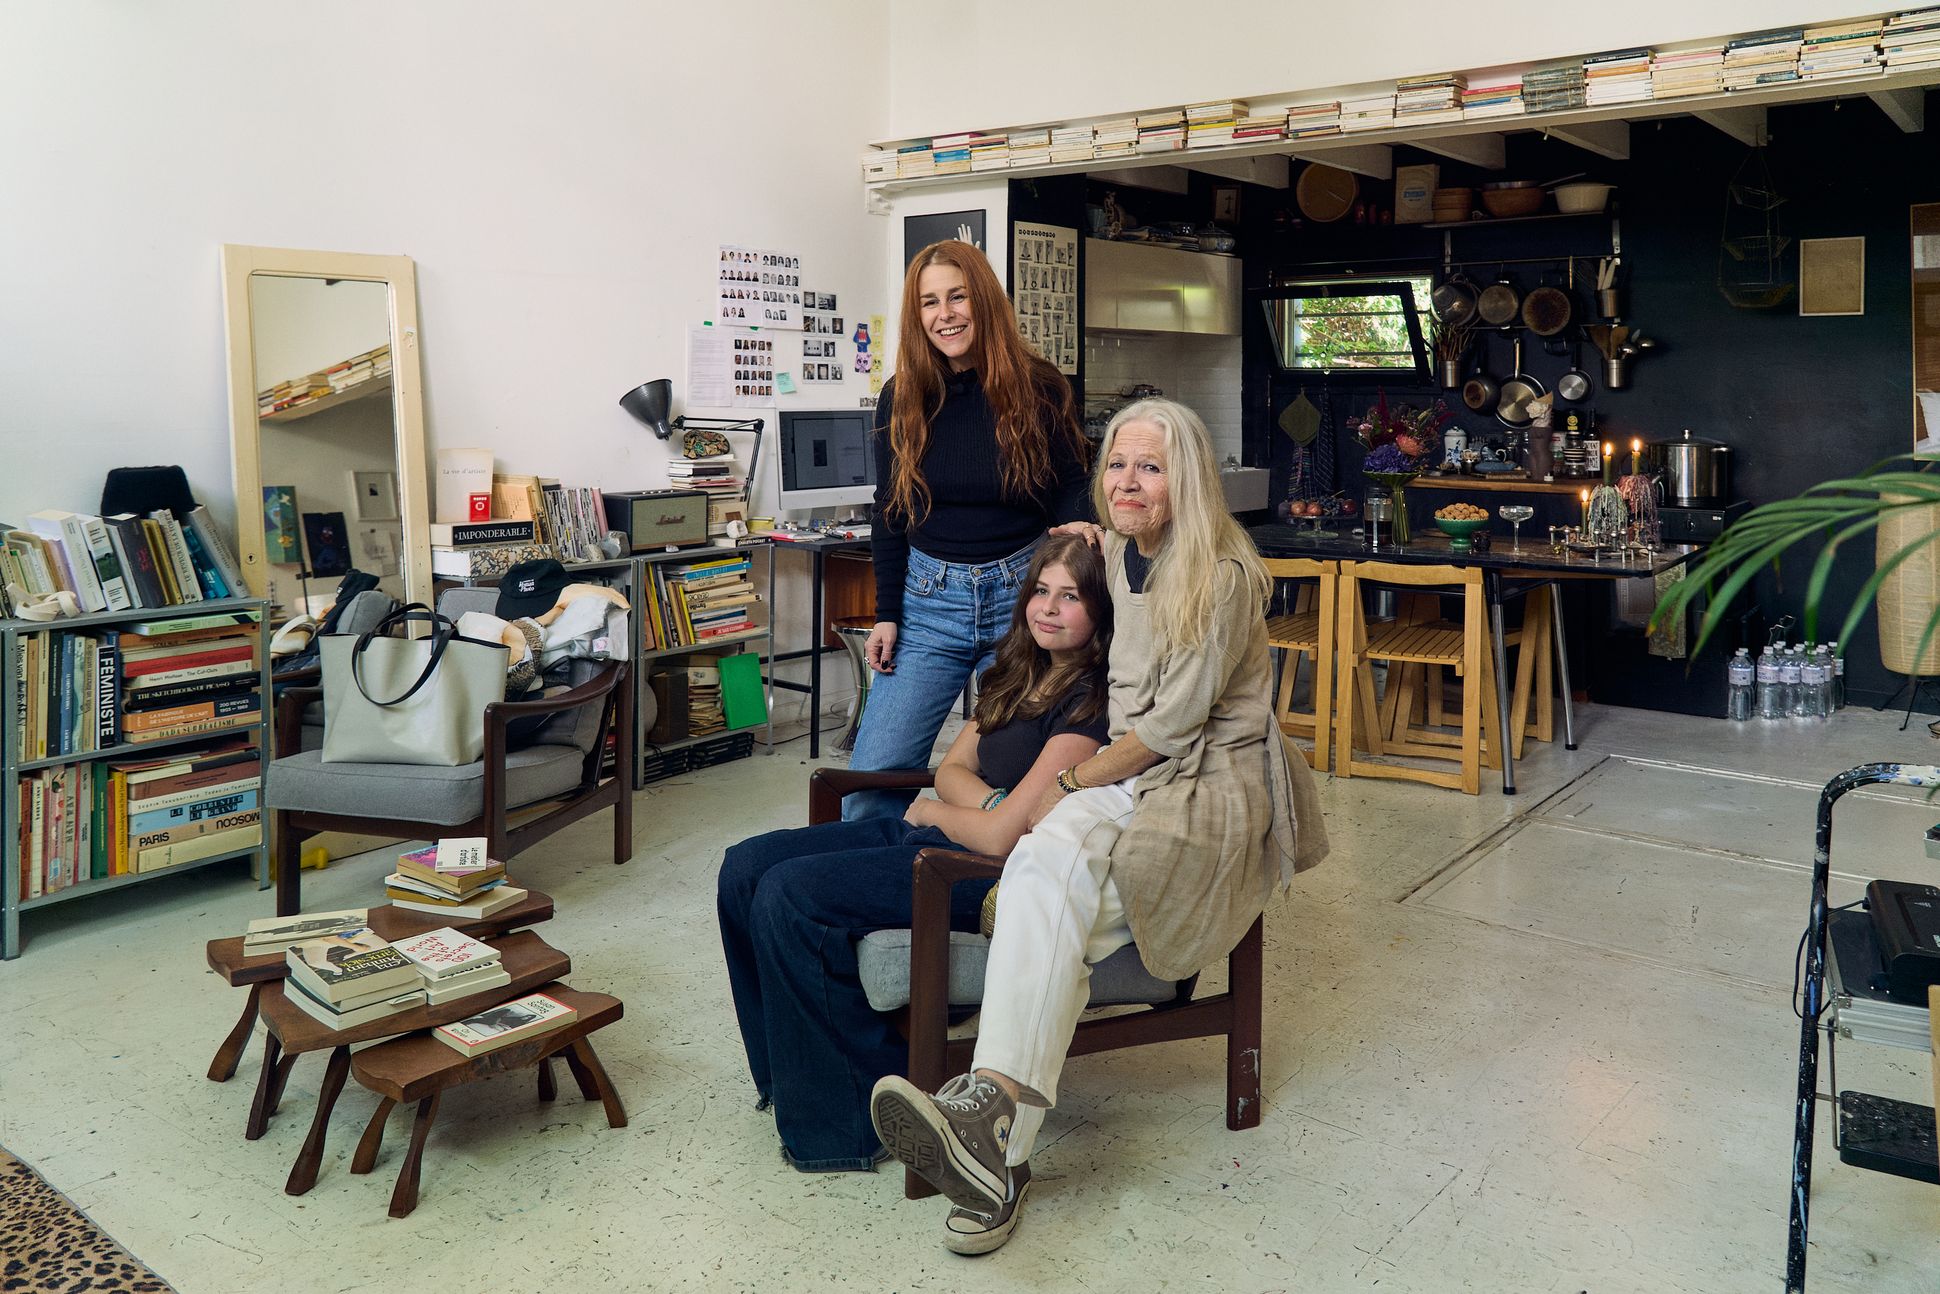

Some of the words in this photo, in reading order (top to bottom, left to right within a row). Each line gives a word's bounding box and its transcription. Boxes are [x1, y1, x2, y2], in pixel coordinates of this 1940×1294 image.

[458, 527, 528, 541] IMPONDERABLE
[100, 657, 115, 737] FÉMINISTE
[152, 686, 196, 698] SKETCHBOOKS
[205, 681, 230, 690] PICASSO
[160, 729, 181, 737] DADA
[215, 812, 260, 830] MOSCOU
[139, 831, 170, 847] PARIS
